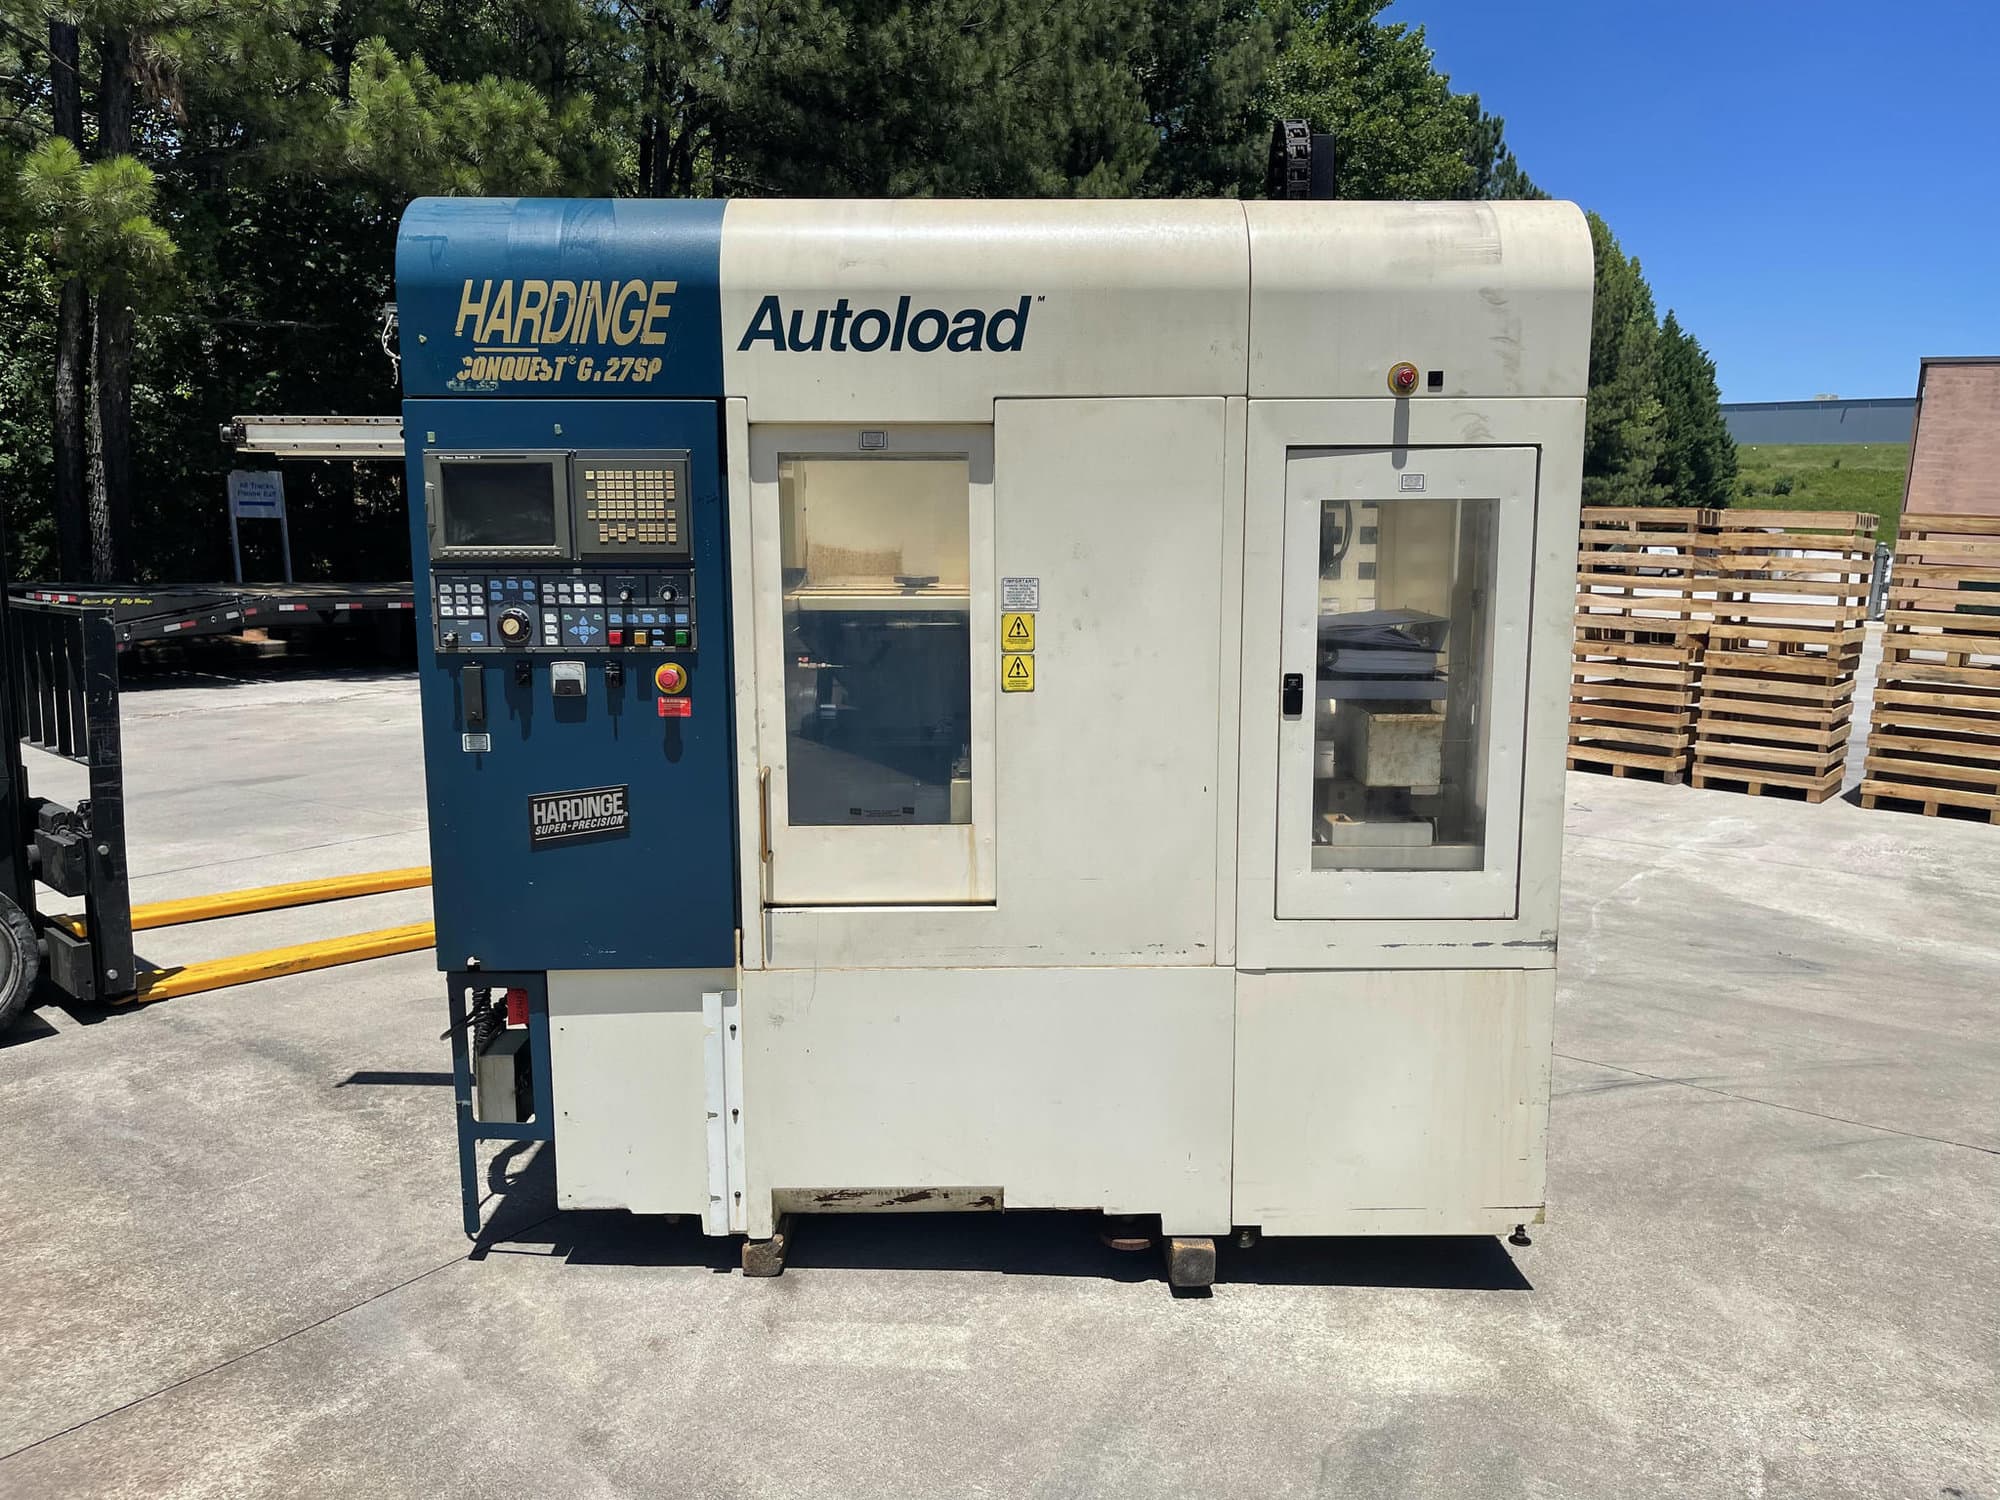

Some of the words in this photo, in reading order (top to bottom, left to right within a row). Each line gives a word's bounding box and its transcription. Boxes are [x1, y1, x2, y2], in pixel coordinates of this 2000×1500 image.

[454, 279, 678, 346] HARDINGE
[533, 792, 625, 825] HARDINGE
[535, 815, 625, 836] SUPER-PRECISION
